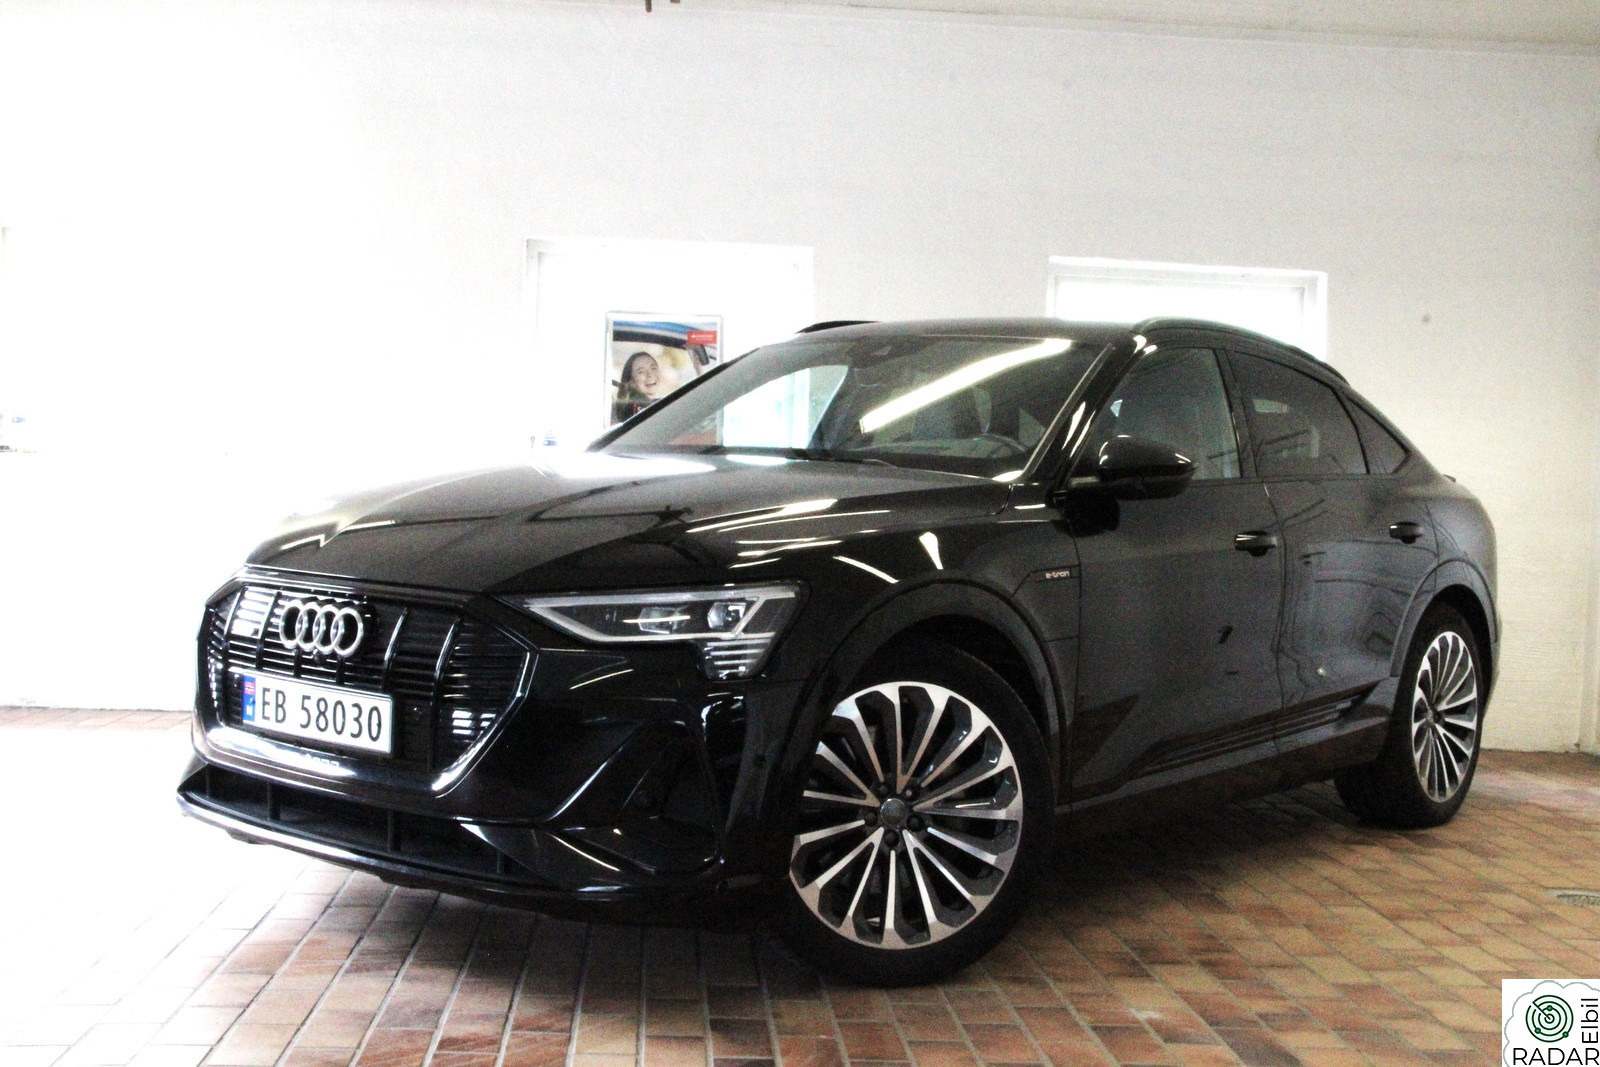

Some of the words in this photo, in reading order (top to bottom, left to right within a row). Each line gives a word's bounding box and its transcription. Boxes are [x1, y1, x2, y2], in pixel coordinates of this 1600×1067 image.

[1045, 571, 1070, 579] e-tron
[246, 705, 253, 716] N
[262, 687, 286, 724] EB
[299, 694, 383, 743] 58030
